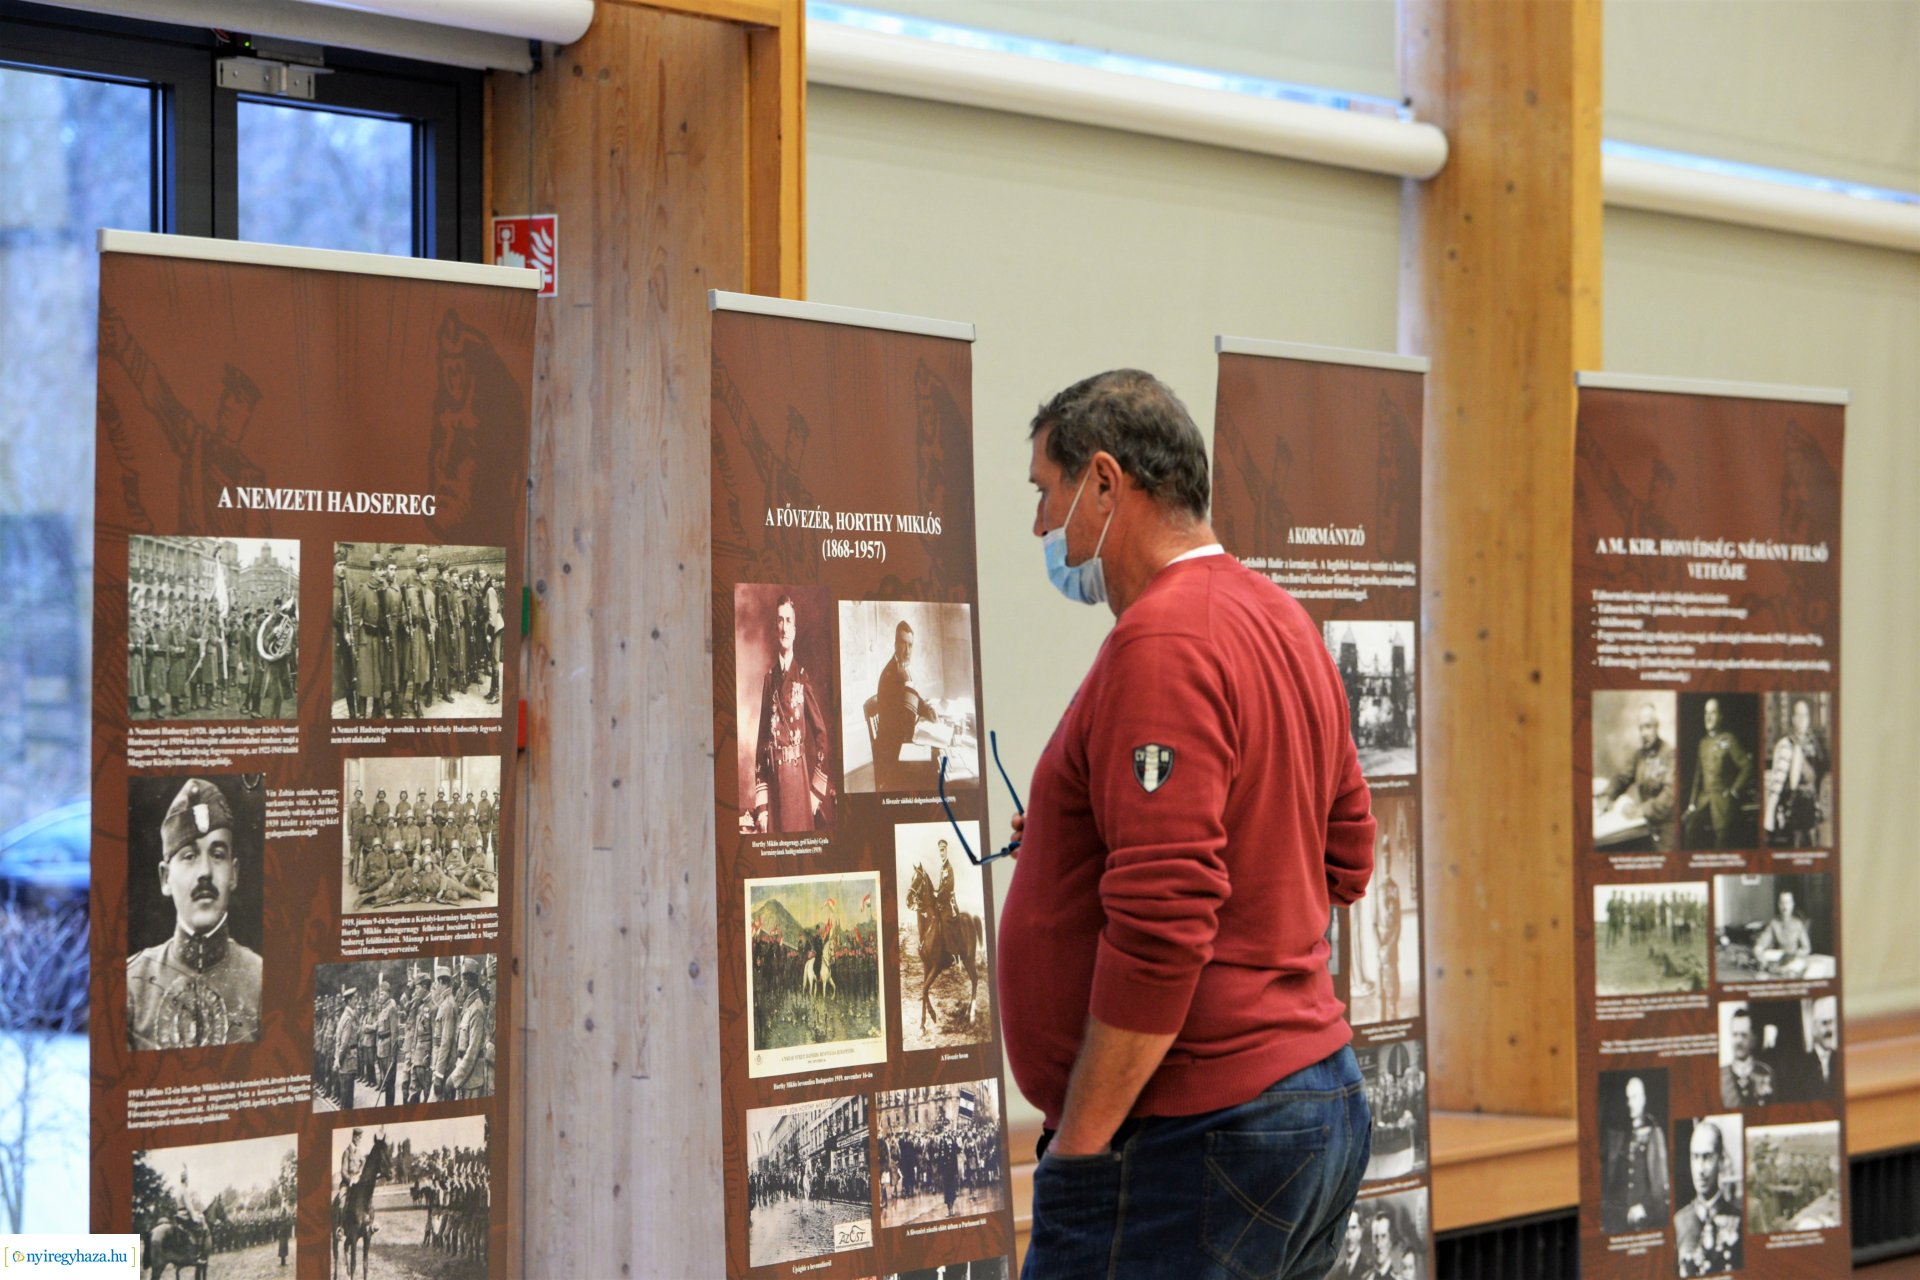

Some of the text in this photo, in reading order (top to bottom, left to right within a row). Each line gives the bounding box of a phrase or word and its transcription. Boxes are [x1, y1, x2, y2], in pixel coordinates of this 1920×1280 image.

[218, 487, 436, 517] A NEMZETI HADSEREG
[764, 503, 942, 535] A FŐVEZÉR, HORTHY MIKLÓS
[1287, 523, 1365, 546] A KORMÁNYZÓ
[822, 538, 886, 564] (1868-1957)
